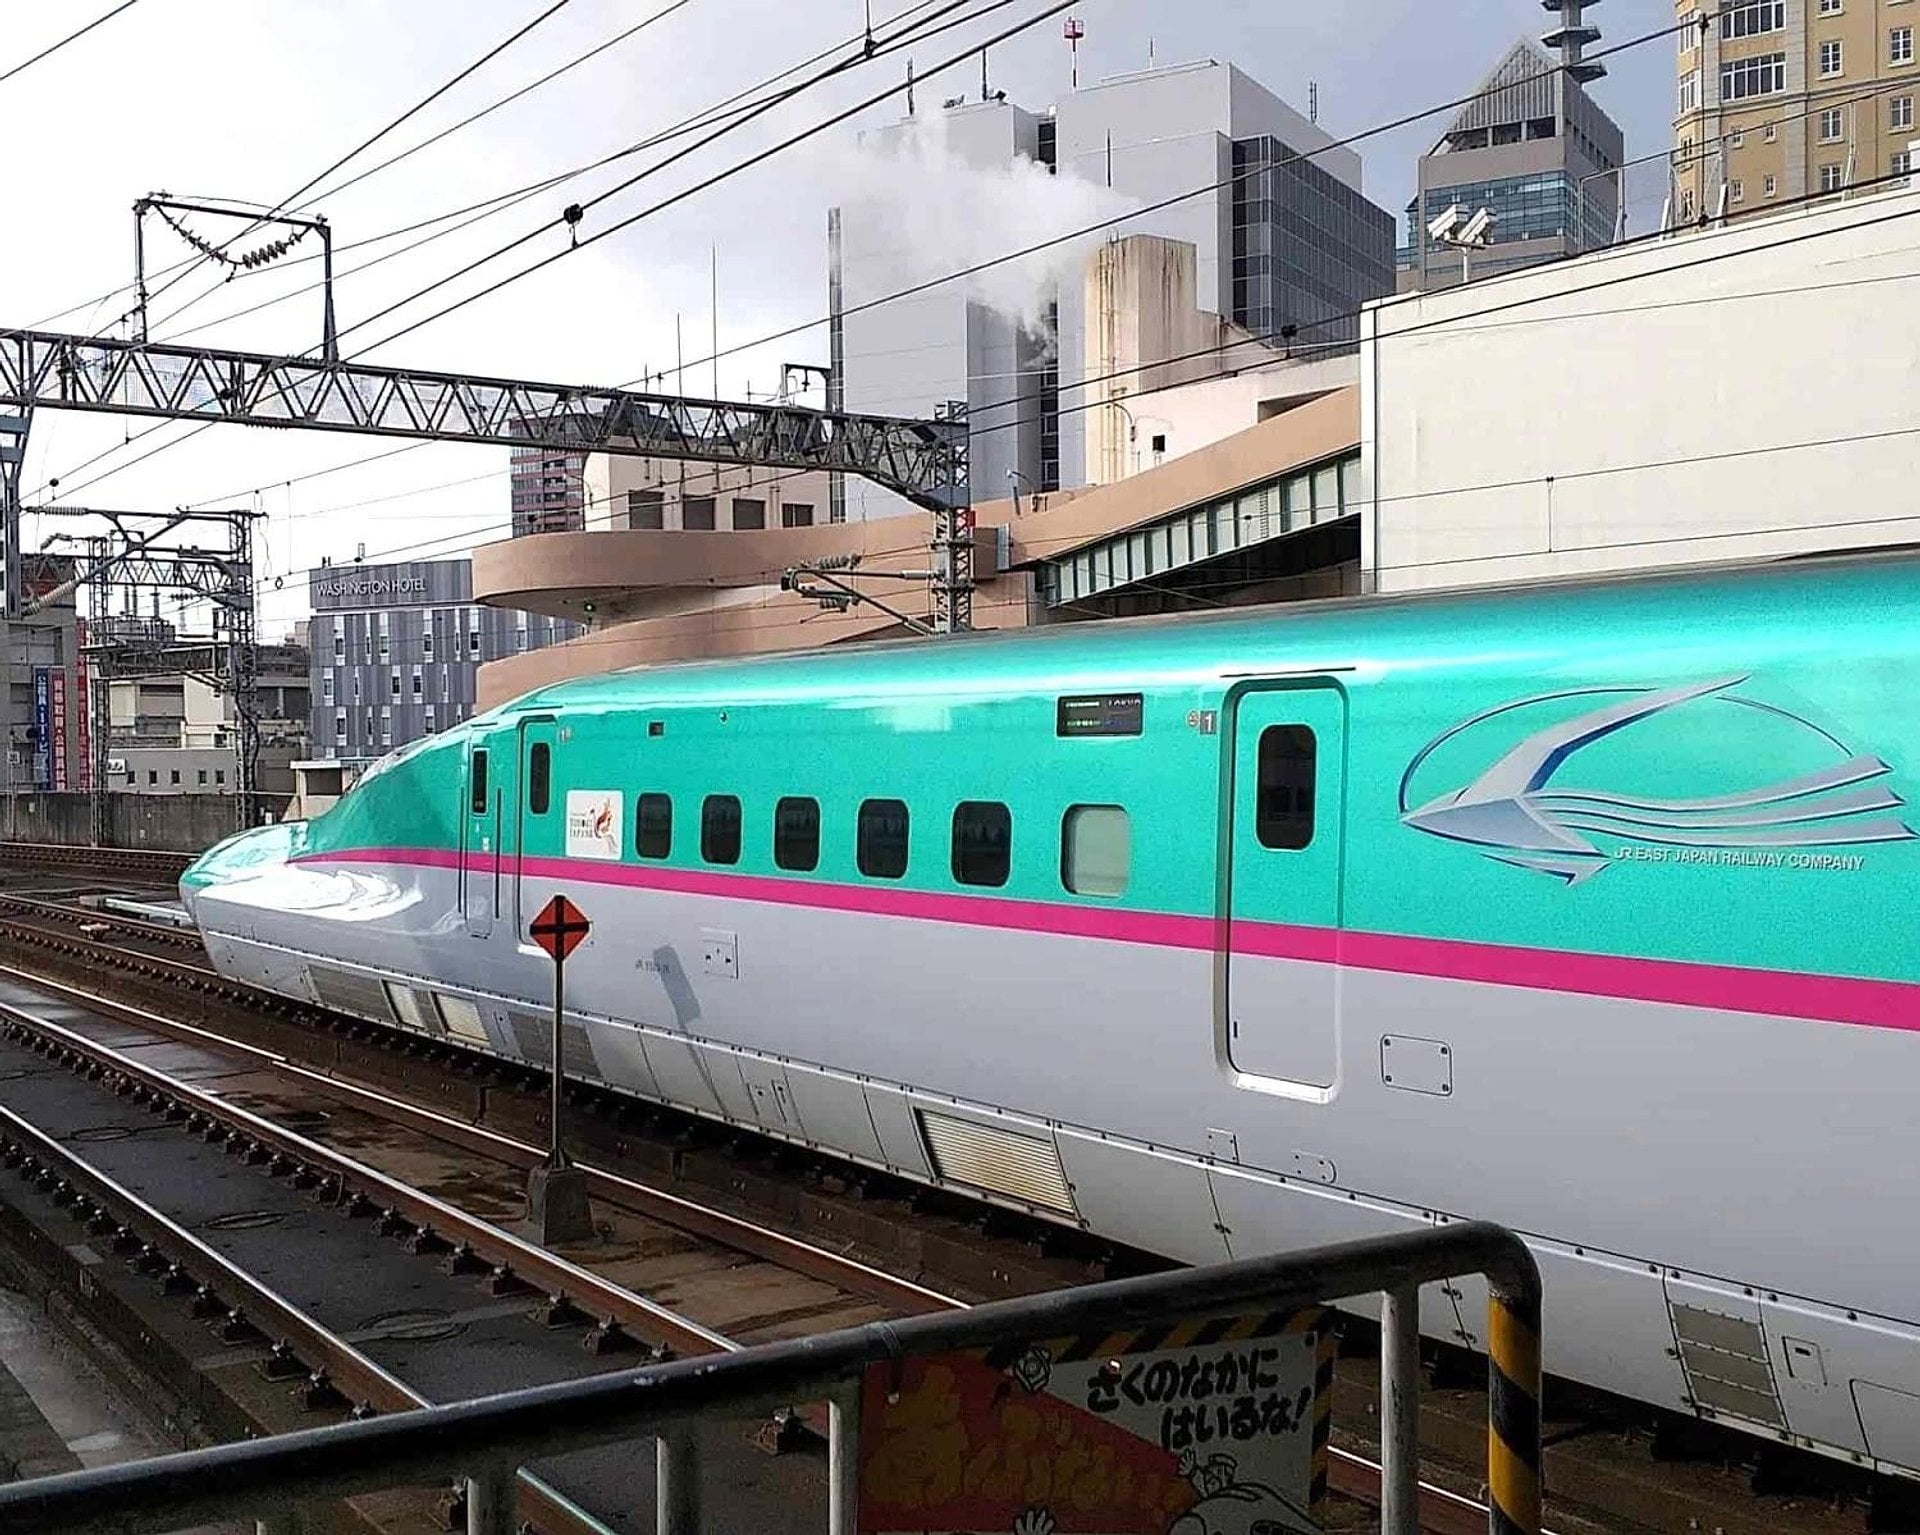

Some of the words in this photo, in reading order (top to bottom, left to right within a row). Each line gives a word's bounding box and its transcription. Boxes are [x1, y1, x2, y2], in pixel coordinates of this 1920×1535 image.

[316, 582, 392, 597] WASHNGTON
[392, 579, 426, 593] HOTEL
[1614, 847, 1633, 860] JR
[1635, 847, 1671, 862] EAST
[1674, 849, 1718, 866] JAPAN
[1722, 852, 1785, 868] RAILWAY
[1788, 854, 1865, 872] COMPANY
[1087, 1349, 1279, 1412] さくのなかに
